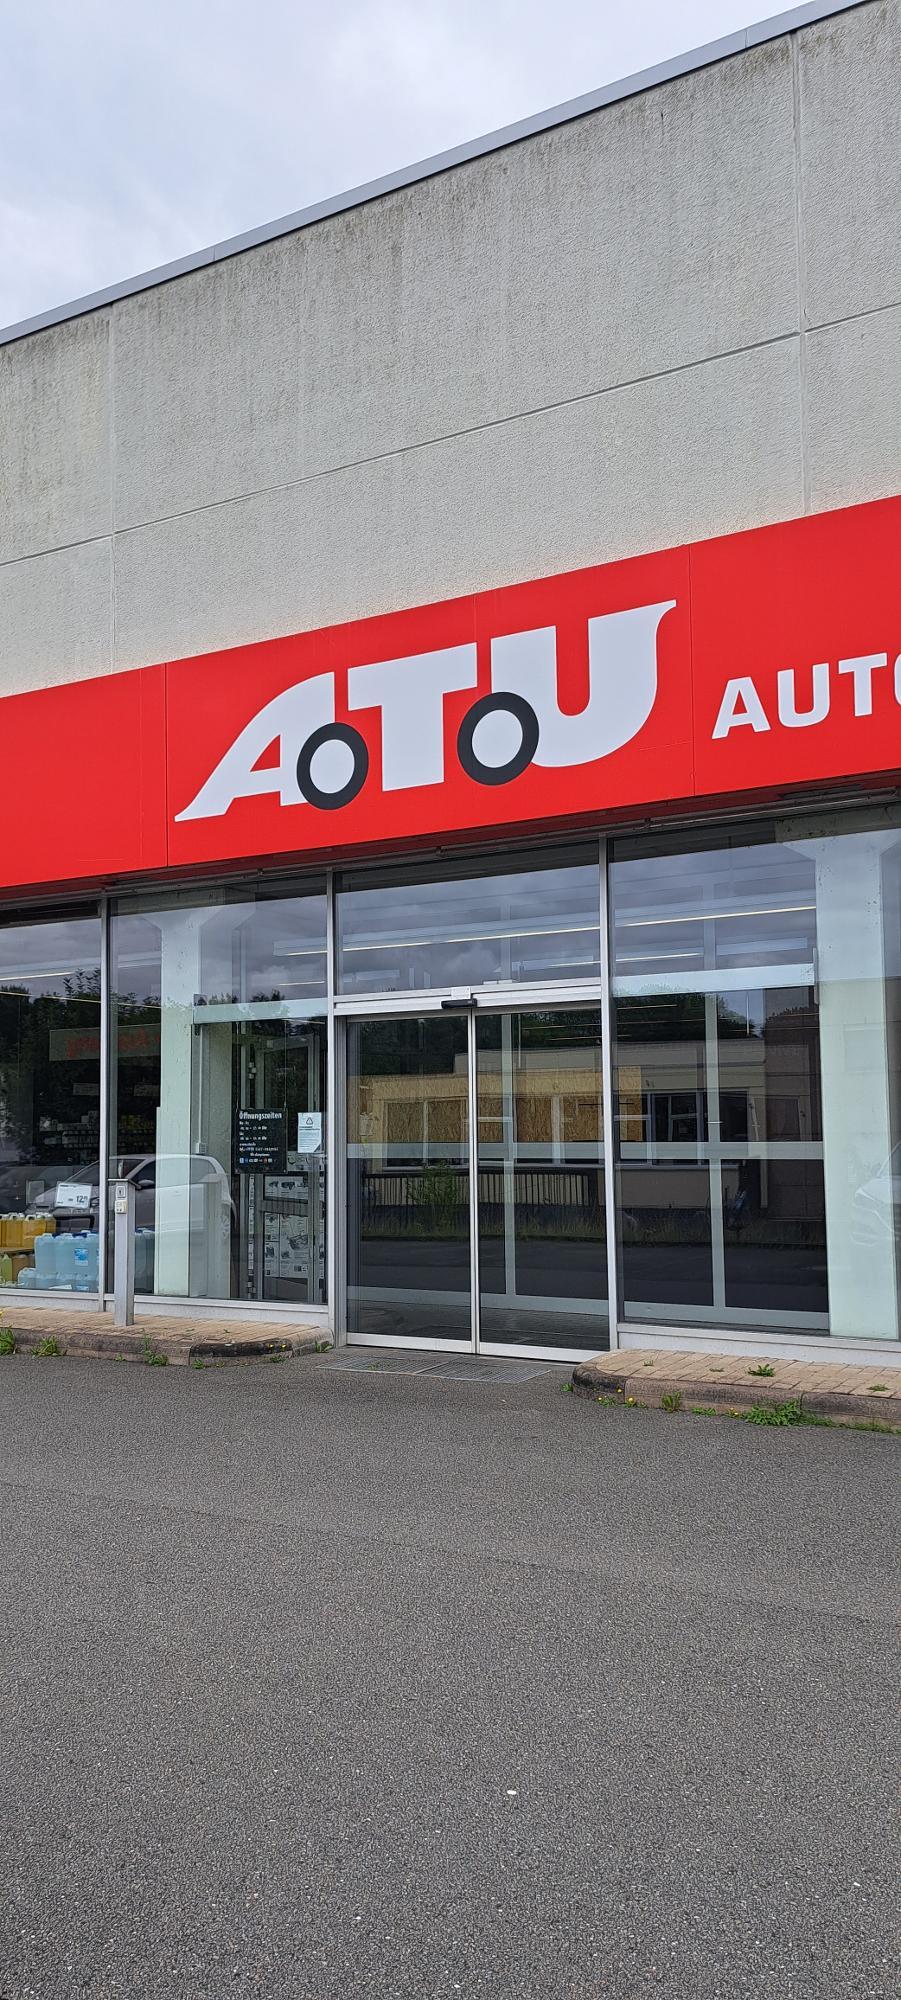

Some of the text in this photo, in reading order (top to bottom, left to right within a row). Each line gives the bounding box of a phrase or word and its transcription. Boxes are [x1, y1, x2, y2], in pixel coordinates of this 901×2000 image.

[175, 599, 676, 822] ATU
[712, 652, 901, 740] AUT
[239, 1111, 282, 1121] Öffnungszeiten
